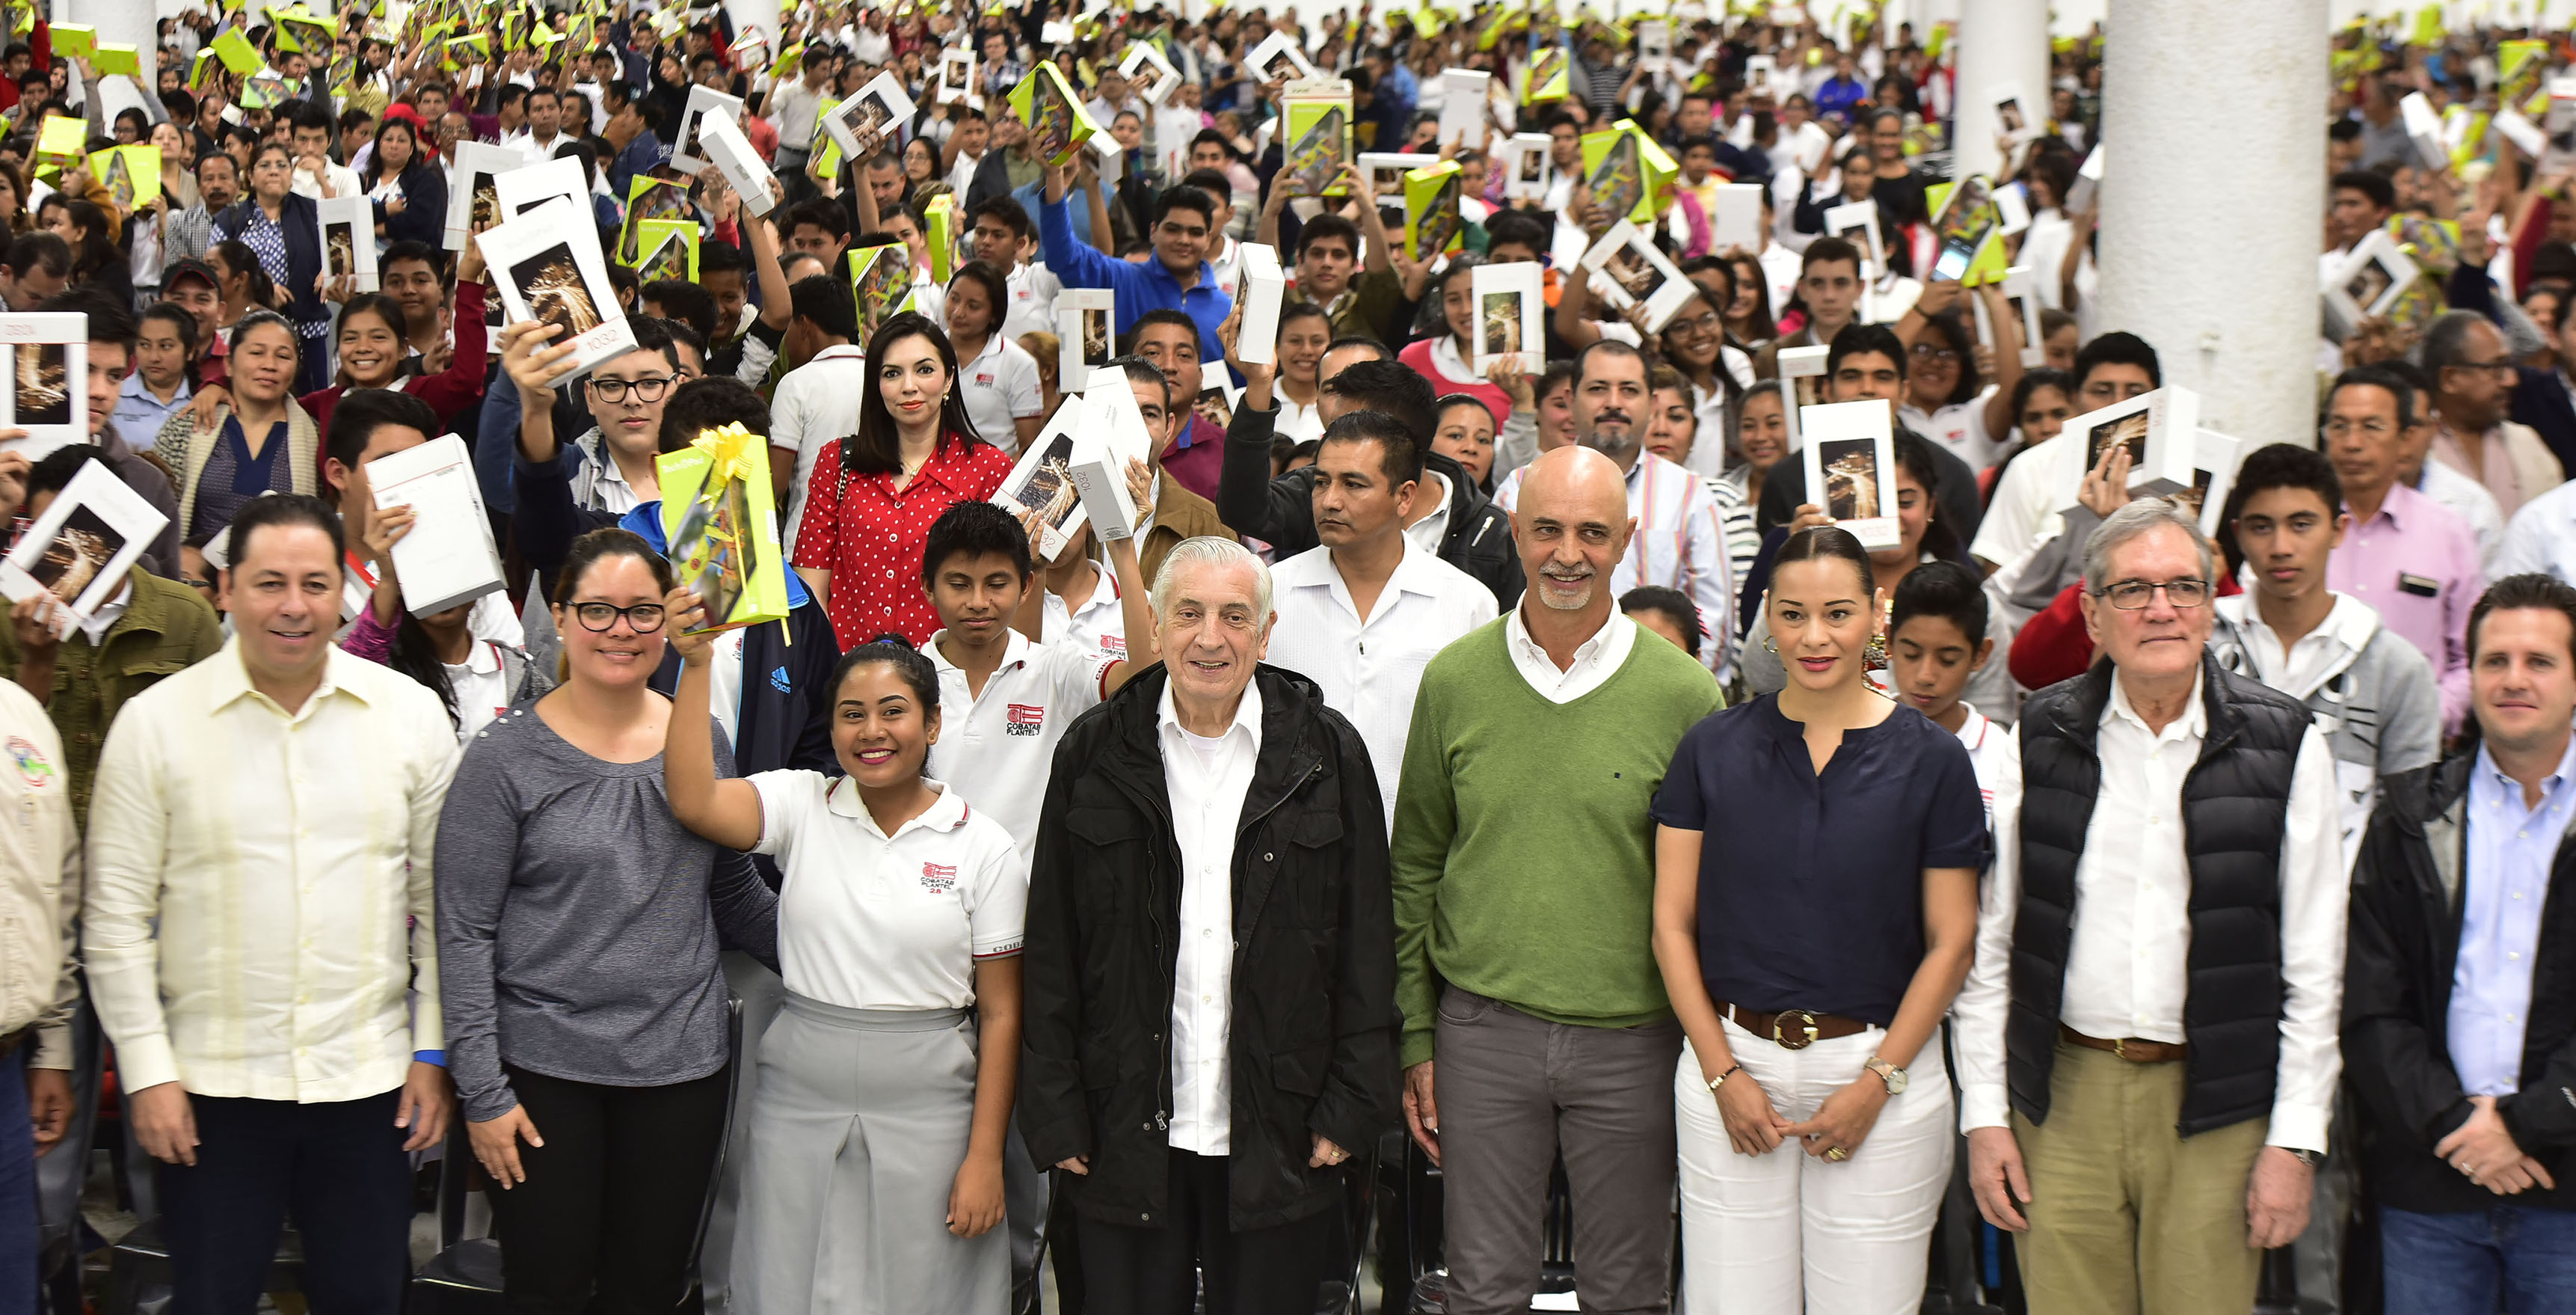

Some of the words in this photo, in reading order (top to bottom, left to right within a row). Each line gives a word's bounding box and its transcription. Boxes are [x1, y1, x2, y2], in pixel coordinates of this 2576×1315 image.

[587, 328, 621, 352] 1032
[1076, 471, 1092, 491] 1032
[1040, 533, 1057, 549] 32
[920, 877, 955, 886] COBATAB
[921, 882, 952, 890] PLANTEL
